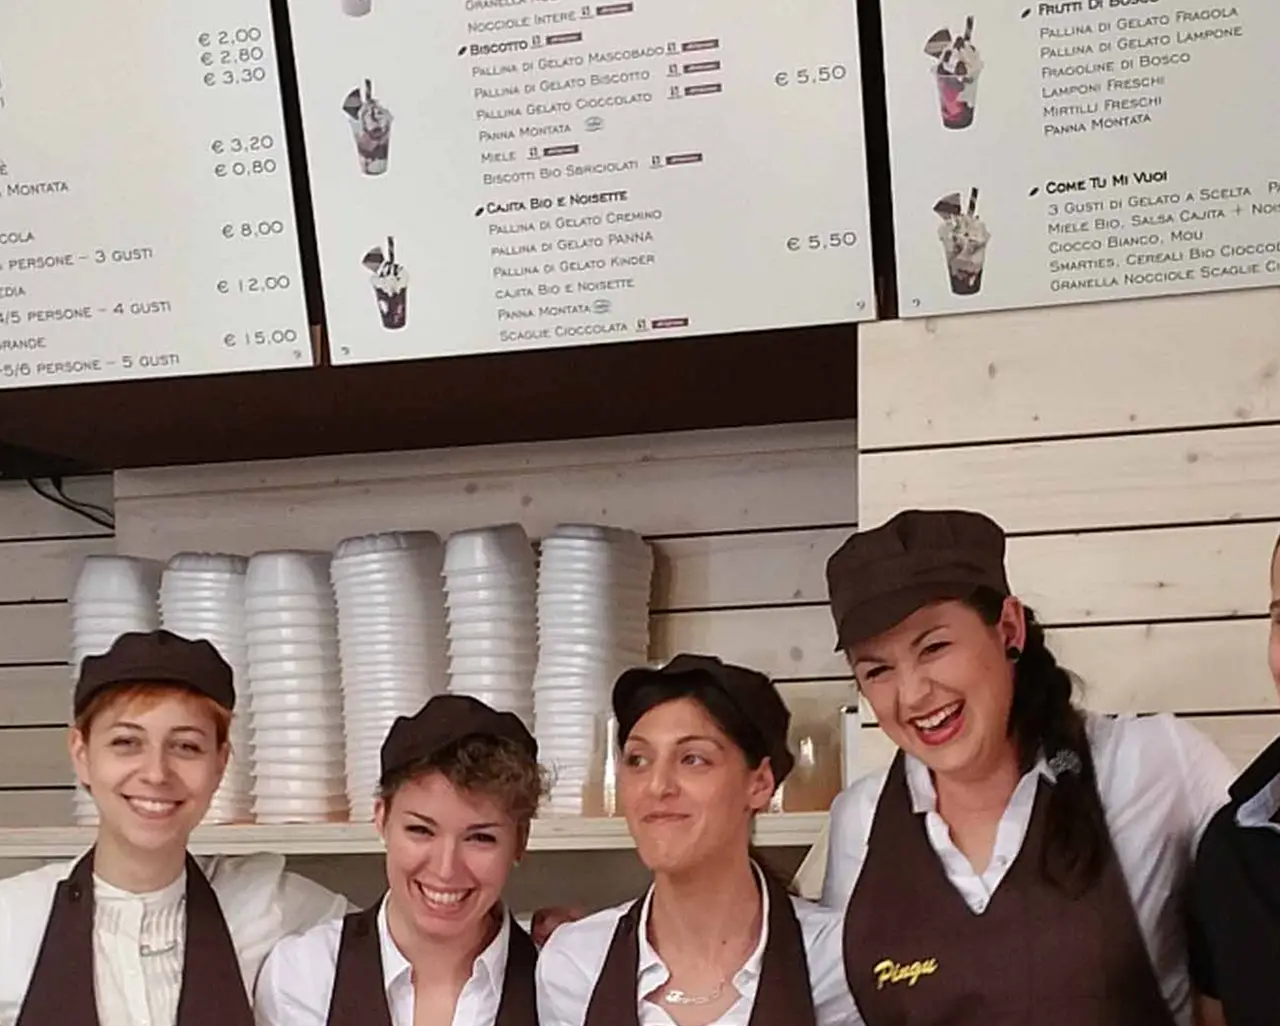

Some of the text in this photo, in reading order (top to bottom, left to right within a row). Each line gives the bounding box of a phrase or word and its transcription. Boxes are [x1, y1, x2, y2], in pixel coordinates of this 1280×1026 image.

[1048, 204, 1059, 216] 3
[95, 250, 106, 263] 3
[113, 302, 124, 315] 4
[122, 355, 133, 368] 5
[873, 955, 939, 990] Pingu
